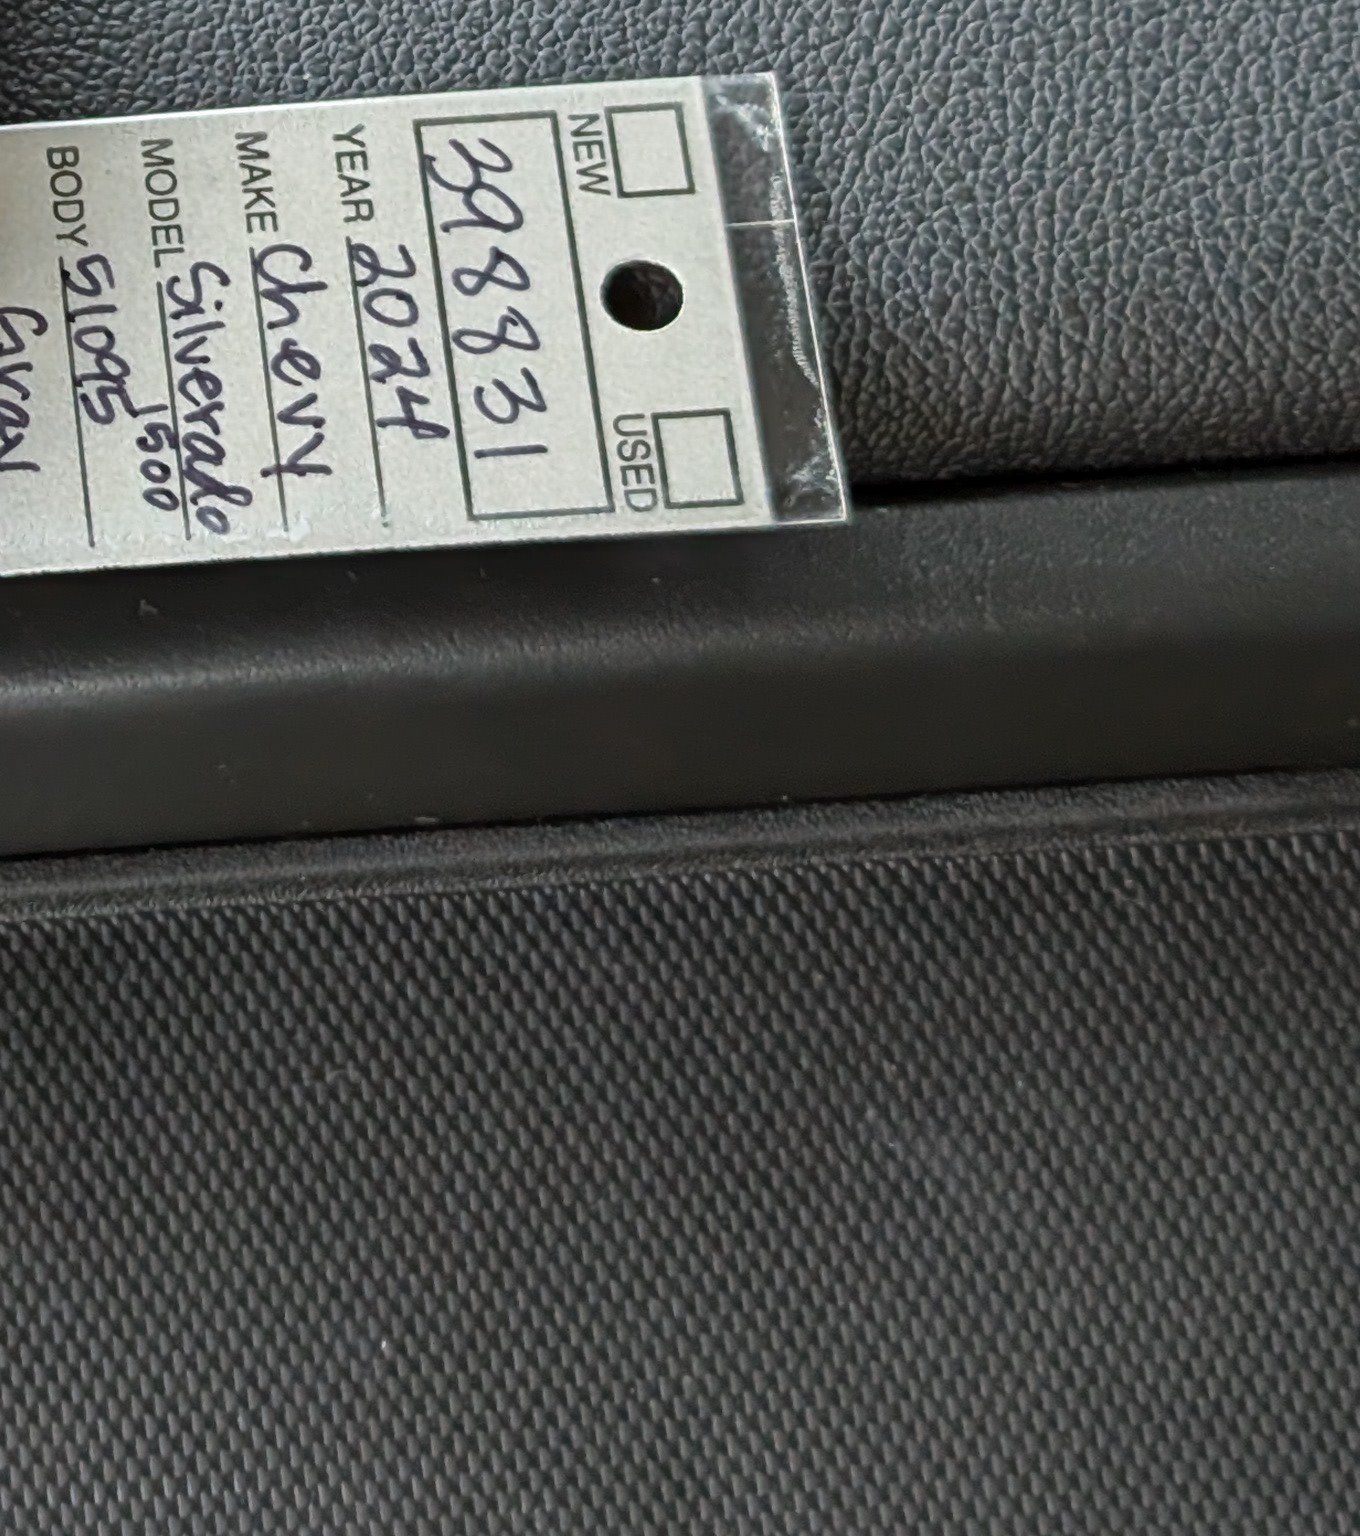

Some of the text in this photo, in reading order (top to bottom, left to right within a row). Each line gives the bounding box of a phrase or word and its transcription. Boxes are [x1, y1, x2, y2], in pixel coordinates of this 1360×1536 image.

[46, 144, 89, 248] BODY
[567, 112, 611, 197] NEW
[140, 137, 253, 535] MODEL Silverado
[234, 130, 333, 479] MAKE Chevy
[331, 123, 451, 441] YEAR 2024
[423, 137, 549, 460] 398831
[129, 403, 181, 512] 1500
[612, 413, 659, 513] USED
